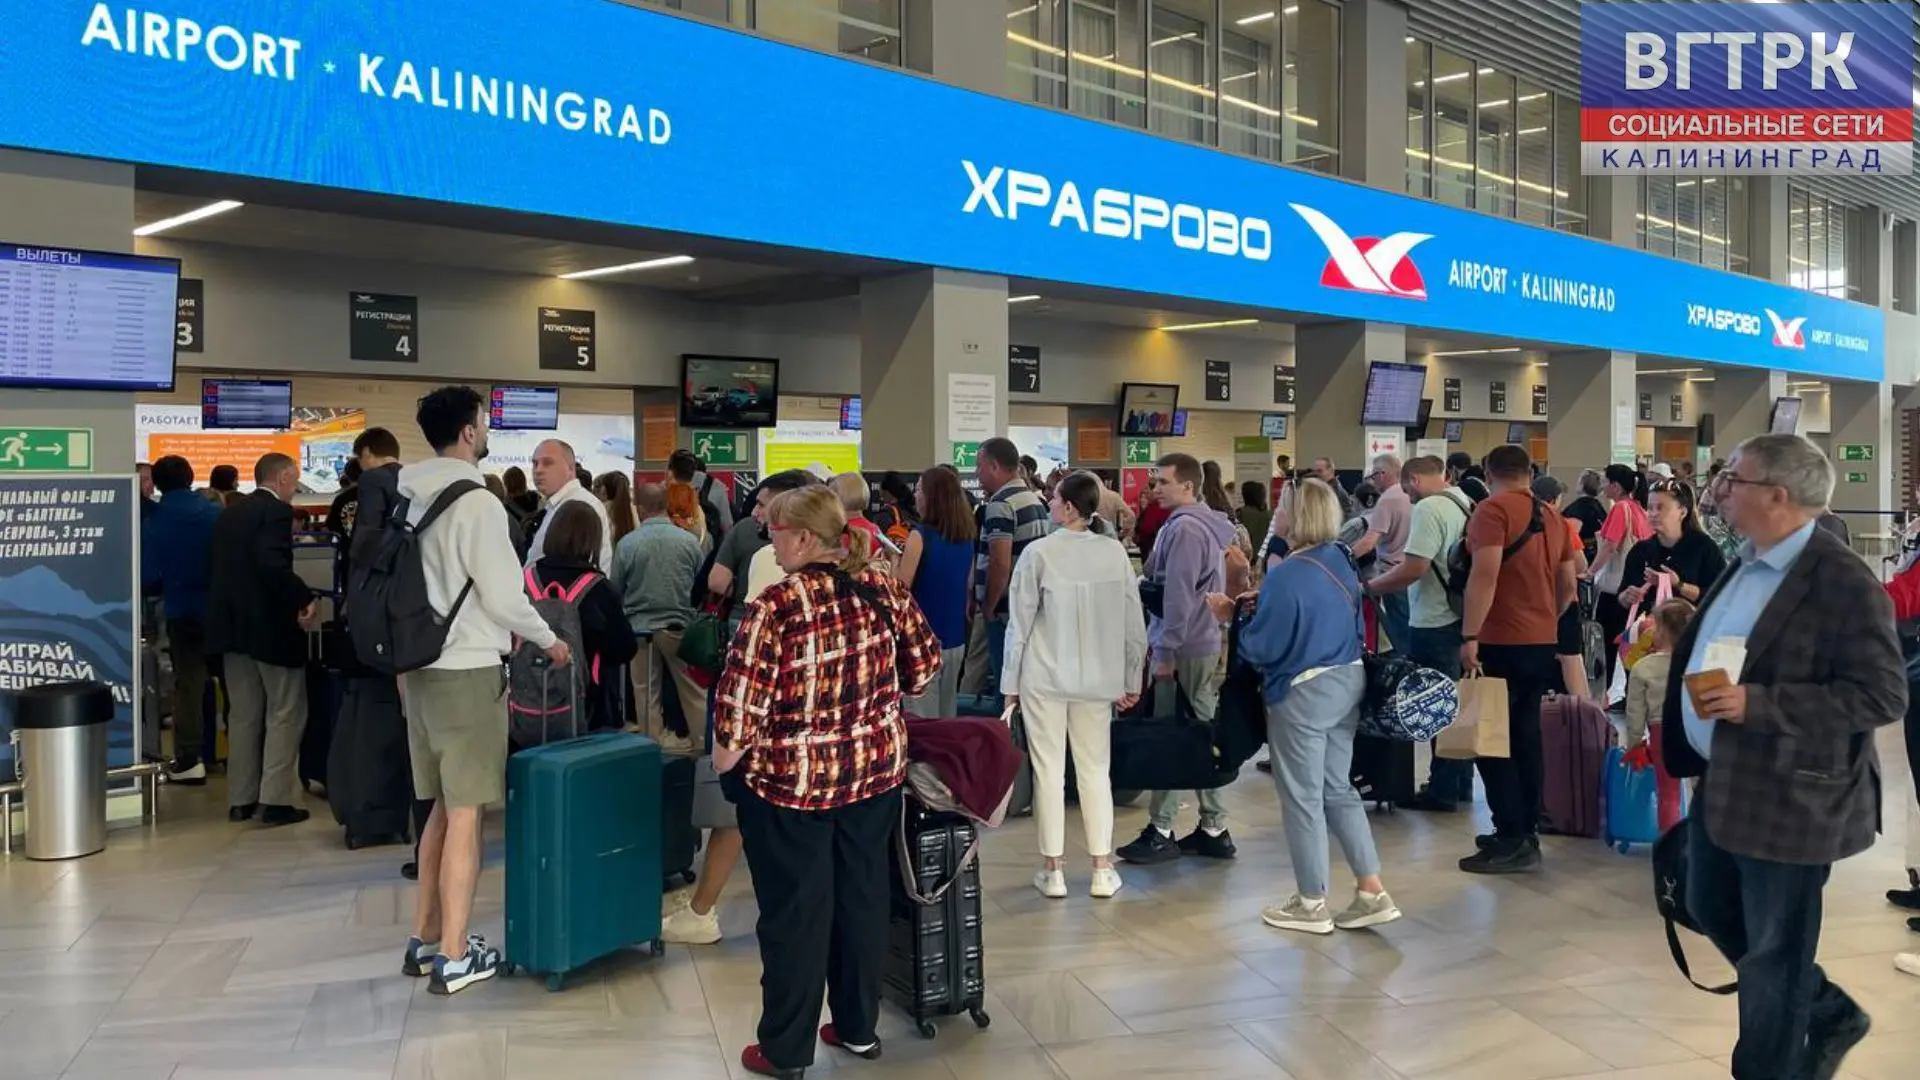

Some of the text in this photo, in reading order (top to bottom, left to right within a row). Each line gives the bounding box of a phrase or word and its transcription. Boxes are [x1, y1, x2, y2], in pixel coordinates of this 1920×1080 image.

[82, 4, 672, 146] AIRPORT KALININGRAD
[961, 160, 1272, 261] ХРАБРОВО
[16, 248, 81, 265] ВЫЛЕТЫ
[1448, 259, 1616, 313] AIRPORT KALININGRAD
[1687, 303, 1761, 336] ХРАБРОВО
[177, 322, 193, 345] 3
[395, 335, 411, 356] 4
[577, 346, 590, 366] 5
[1029, 373, 1037, 389] 7
[1221, 384, 1229, 399] 8
[1287, 388, 1295, 401] 9
[141, 415, 199, 425] РАБОТАЕТ
[0, 488, 115, 505] ИАЛЬНЫЙ ФАН-ШОП
[17, 507, 84, 522] «БАЛТИКА»
[62, 525, 71, 538] 3
[73, 527, 104, 539] этаж
[0, 542, 95, 558] ТЕАТРАЛЬНАЯ 30
